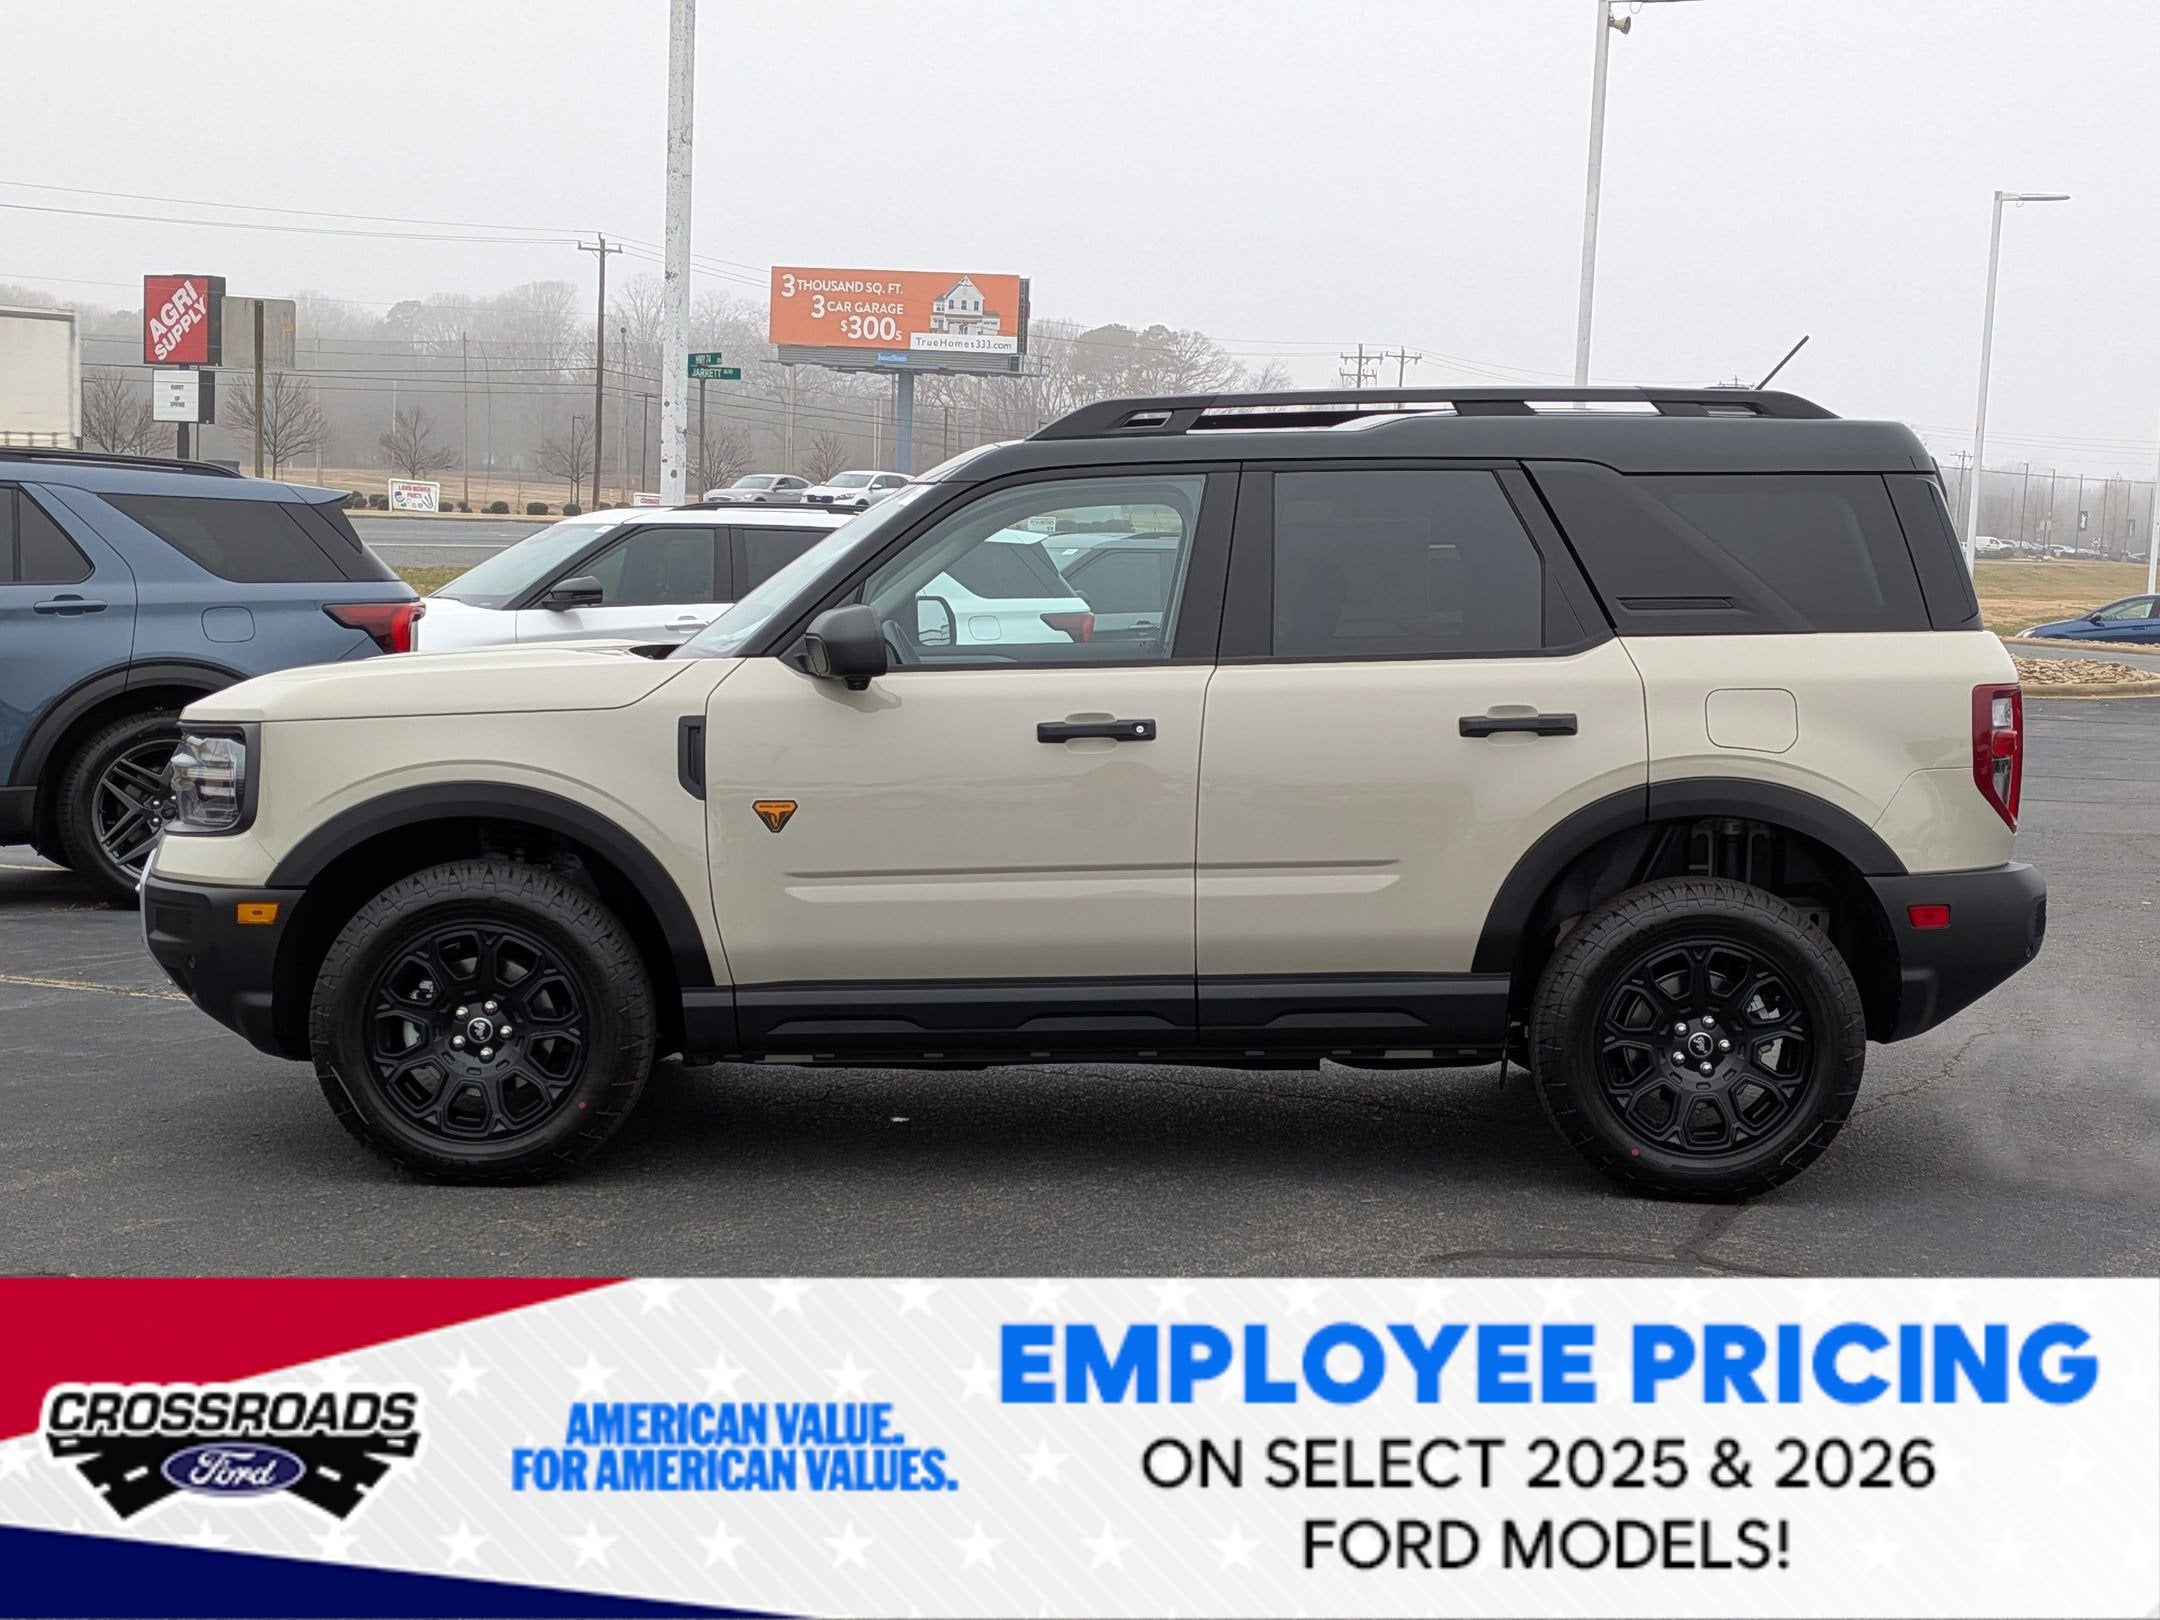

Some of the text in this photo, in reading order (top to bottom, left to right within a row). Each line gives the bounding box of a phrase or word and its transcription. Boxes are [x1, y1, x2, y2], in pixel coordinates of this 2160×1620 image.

[781, 273, 904, 298] 3 THOUSAND SQ. FT.
[149, 280, 198, 343] AGRI
[811, 295, 904, 319] 3 CAR GARAGE
[154, 294, 207, 361] SUPPLY
[915, 336, 1013, 351] TrueHomes333.com
[692, 367, 722, 378] JARRETT
